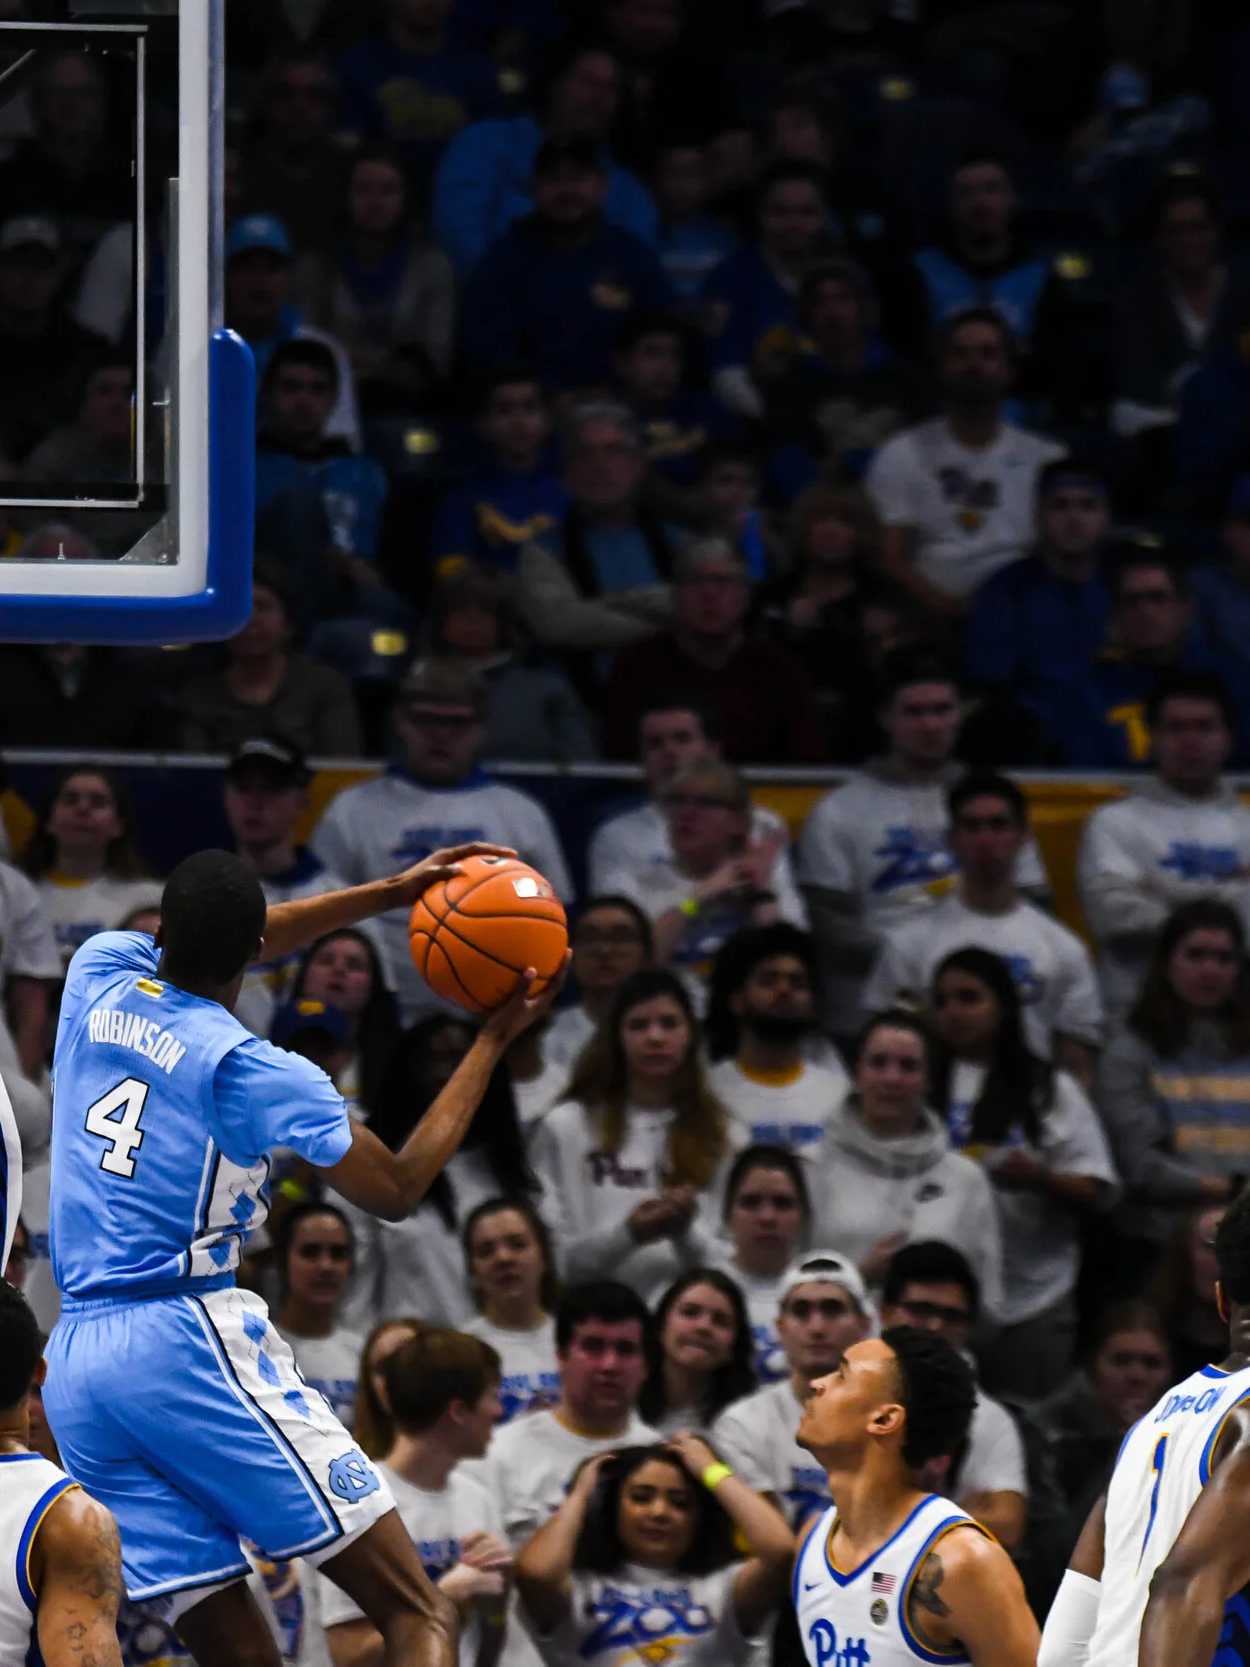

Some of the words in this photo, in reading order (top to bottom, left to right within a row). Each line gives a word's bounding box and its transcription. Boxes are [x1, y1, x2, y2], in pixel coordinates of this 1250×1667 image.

[88, 1009, 187, 1075] ROBINSON
[85, 1076, 150, 1179] 4
[1135, 1432, 1169, 1578] 1
[808, 1618, 870, 1667] Pitt
